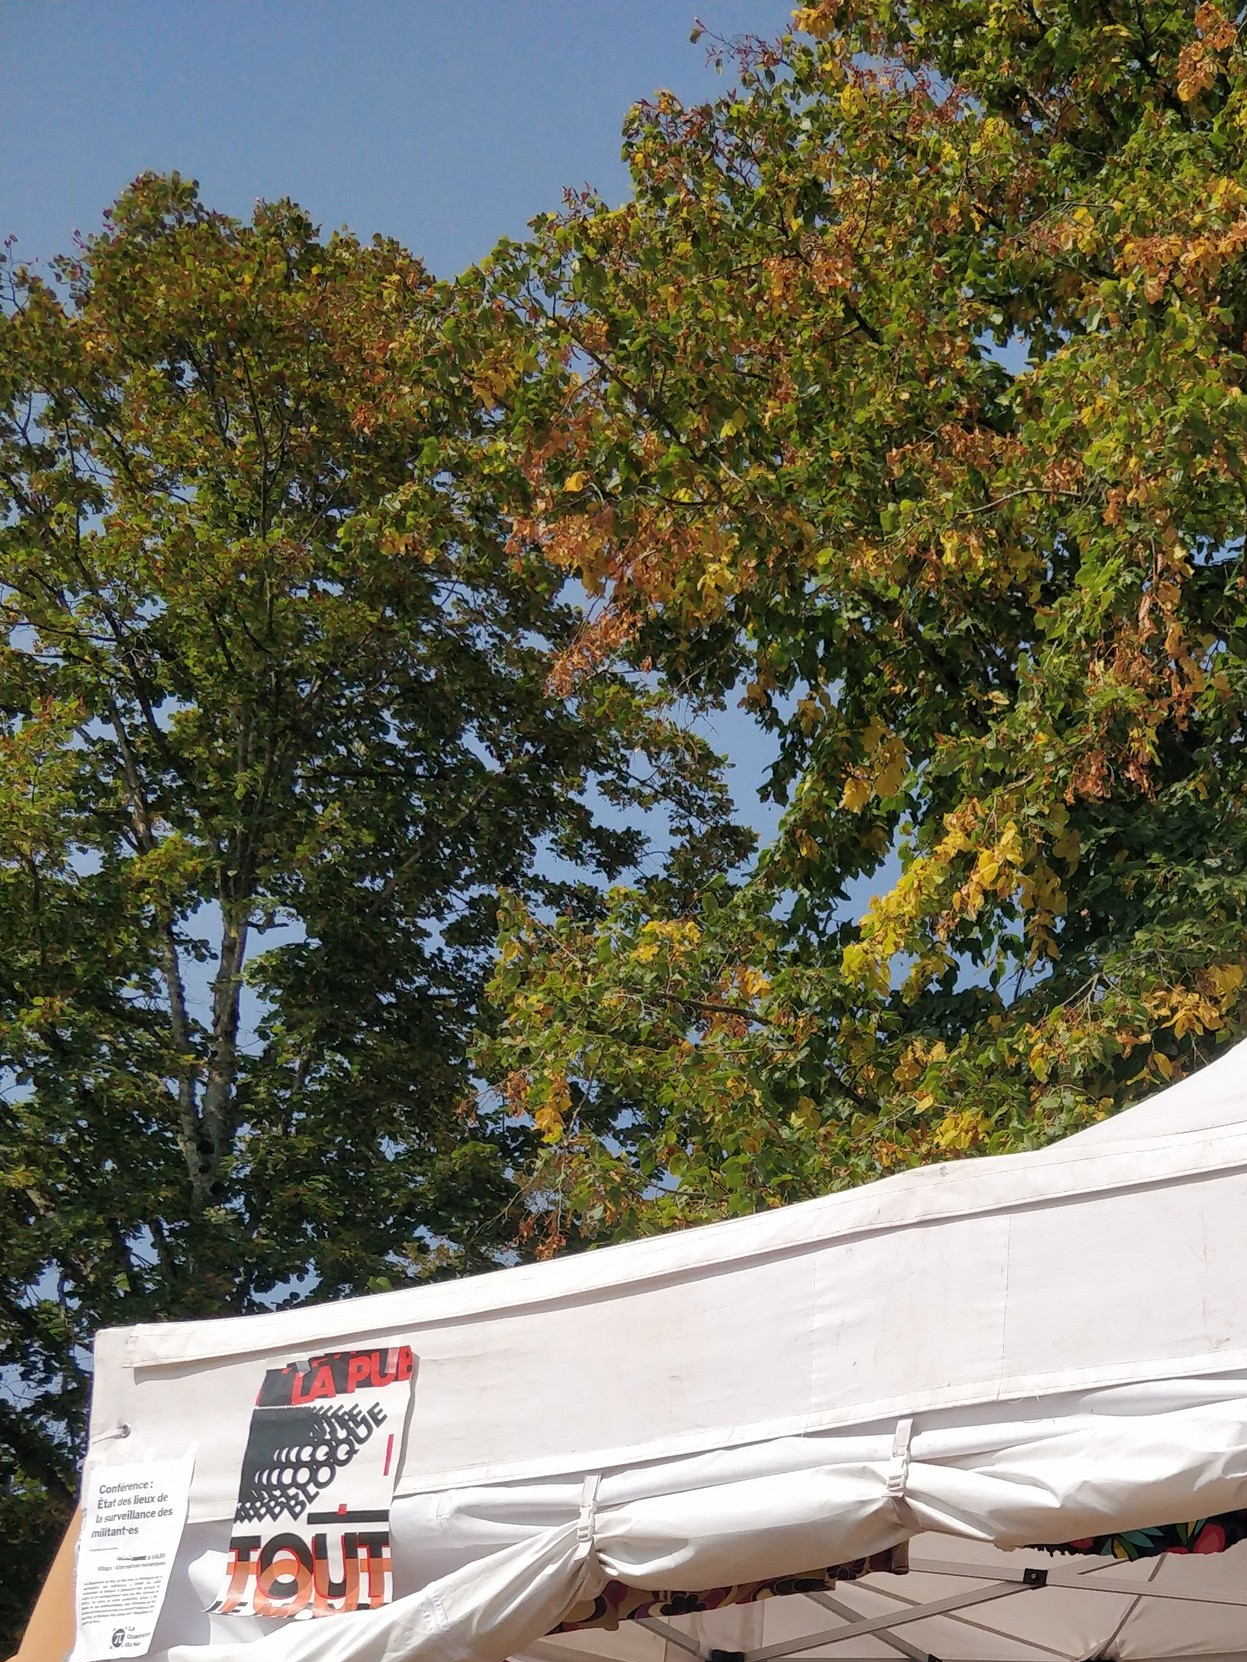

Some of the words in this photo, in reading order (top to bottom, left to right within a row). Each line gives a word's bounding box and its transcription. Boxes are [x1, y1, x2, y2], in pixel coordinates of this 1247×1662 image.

[292, 1366, 336, 1405] LA
[99, 1482, 148, 1494] Conférence
[97, 1497, 116, 1509] État
[118, 1497, 132, 1506] des
[134, 1495, 155, 1504] lieux
[157, 1493, 168, 1502] de
[96, 1515, 102, 1523] la
[104, 1510, 156, 1522] surveillance
[158, 1507, 173, 1517] des
[226, 1532, 392, 1613] TOUT
